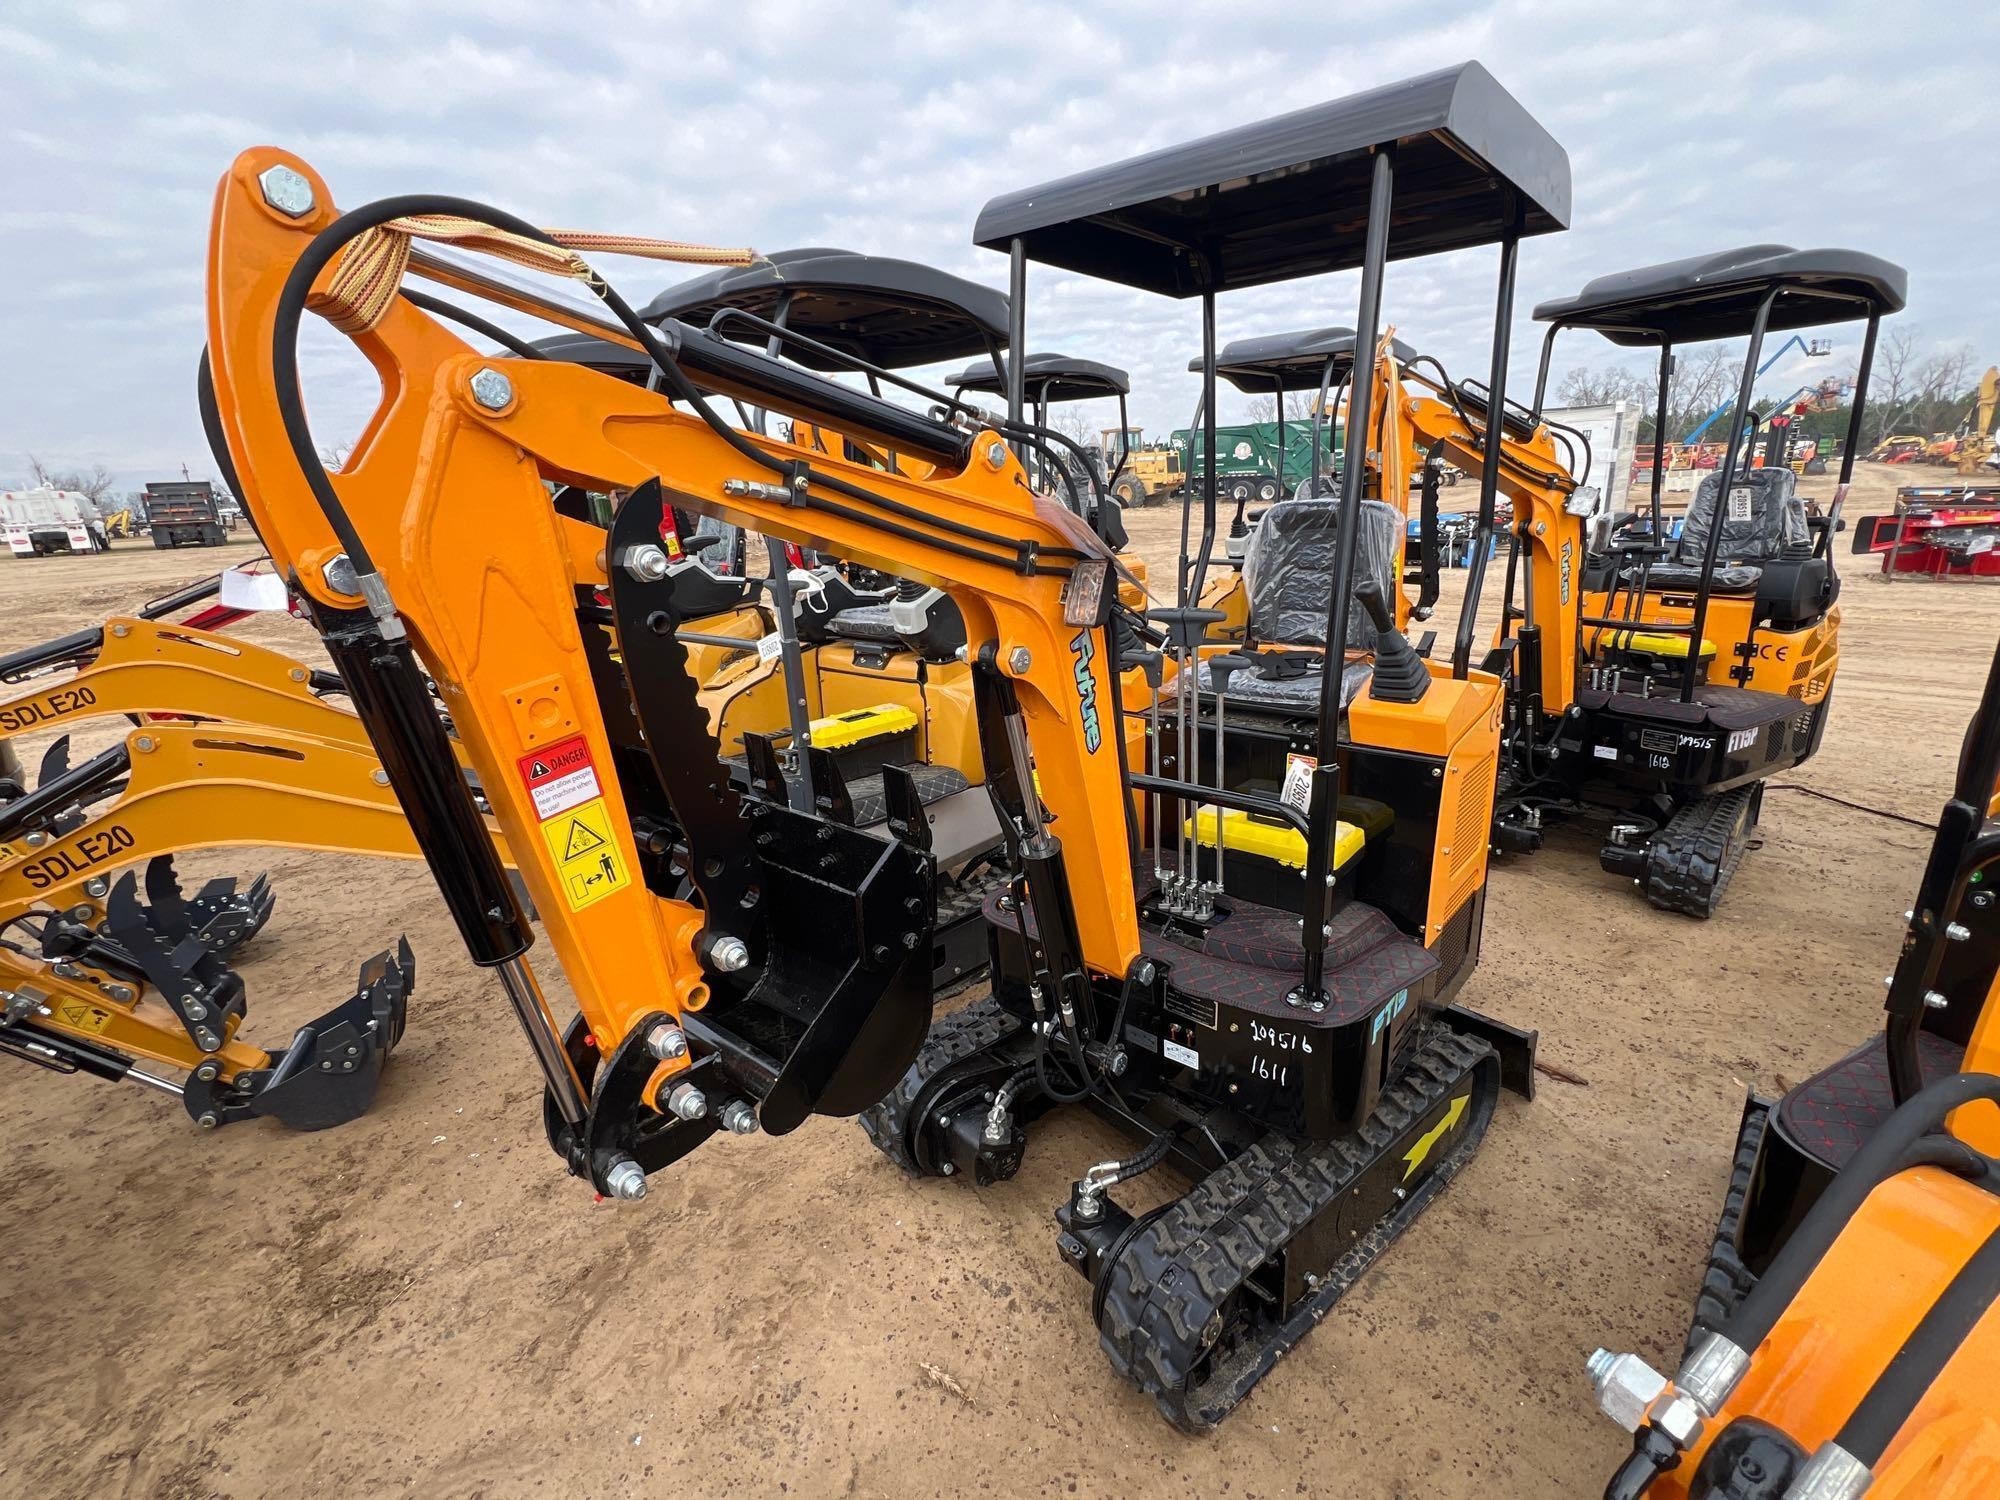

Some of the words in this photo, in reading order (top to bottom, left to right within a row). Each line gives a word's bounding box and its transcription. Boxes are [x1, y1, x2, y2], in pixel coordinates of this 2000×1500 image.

[1561, 537, 1573, 606] Future
[1760, 645, 1789, 662] CE
[1070, 627, 1102, 755] Future
[0, 687, 97, 731] SDLE20
[550, 748, 586, 771] DANGER
[1649, 753, 1671, 769] 1612
[534, 790, 545, 798] Do
[545, 785, 556, 793] not
[556, 779, 572, 789] allow
[572, 770, 592, 783] people
[538, 797, 552, 806] near
[552, 787, 577, 800] machine
[577, 780, 593, 790] when
[23, 825, 135, 889] SDLE20
[1250, 1020, 1313, 1054] 209516
[1251, 1055, 1287, 1087] 1611
